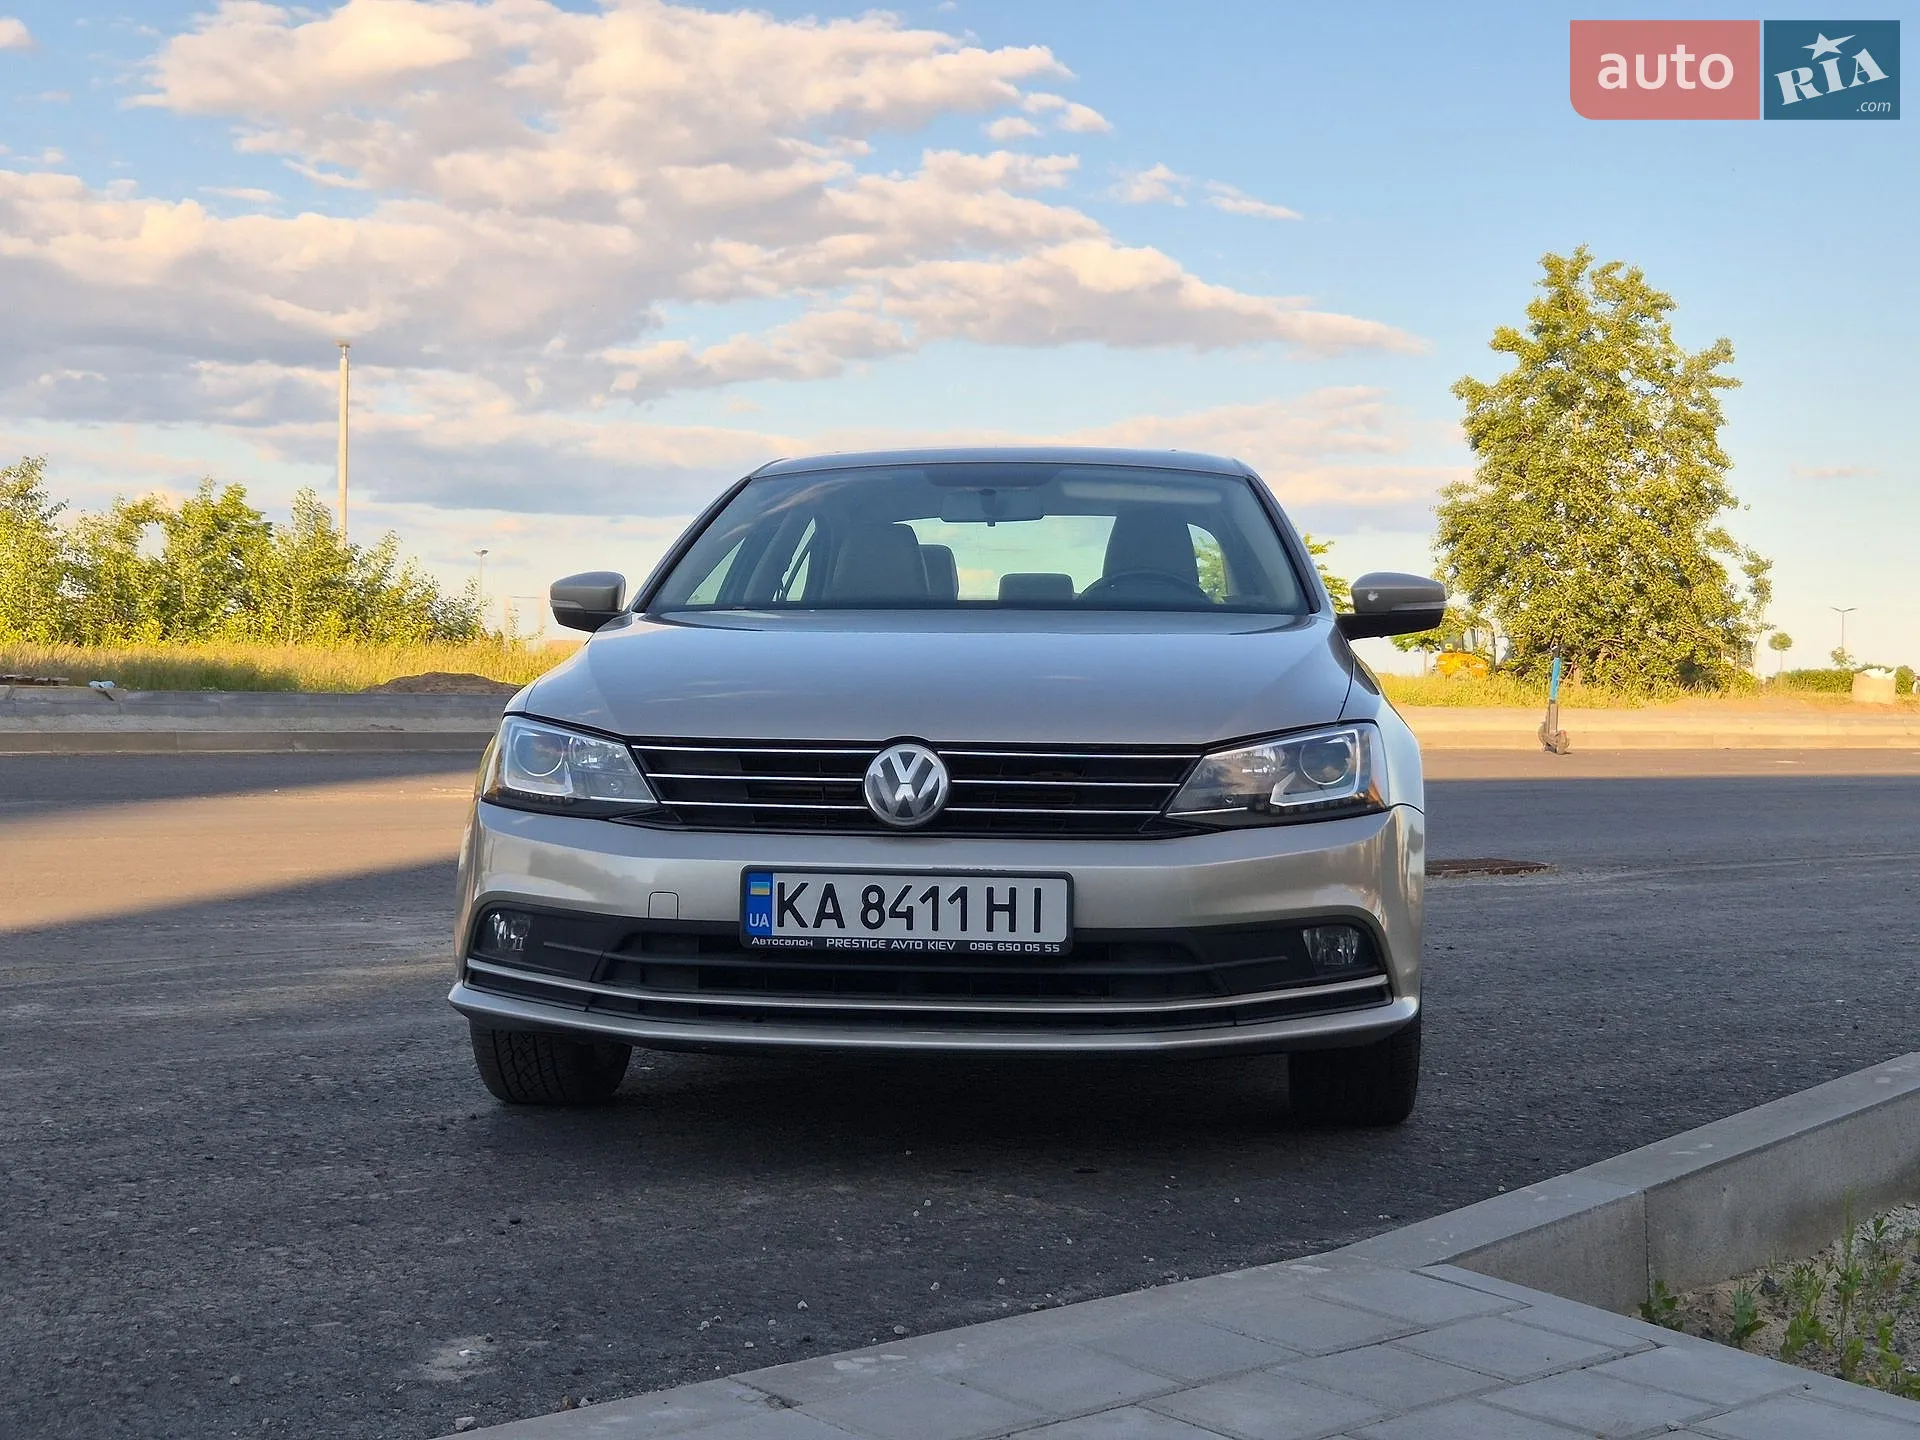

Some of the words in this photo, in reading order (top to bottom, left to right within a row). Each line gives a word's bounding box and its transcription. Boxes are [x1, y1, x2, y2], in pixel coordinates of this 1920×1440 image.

[776, 881, 846, 929] KA
[861, 885, 968, 932] 8411
[986, 886, 1042, 933] HI
[749, 913, 770, 928] UA
[751, 936, 814, 947] Автосалон
[826, 938, 886, 949] PRESTIGE
[890, 940, 925, 950] AVTO
[927, 941, 956, 951] KIEV
[969, 942, 994, 951] 096
[997, 943, 1021, 952] 650
[1024, 943, 1040, 952] 05
[1044, 944, 1060, 953] 55
